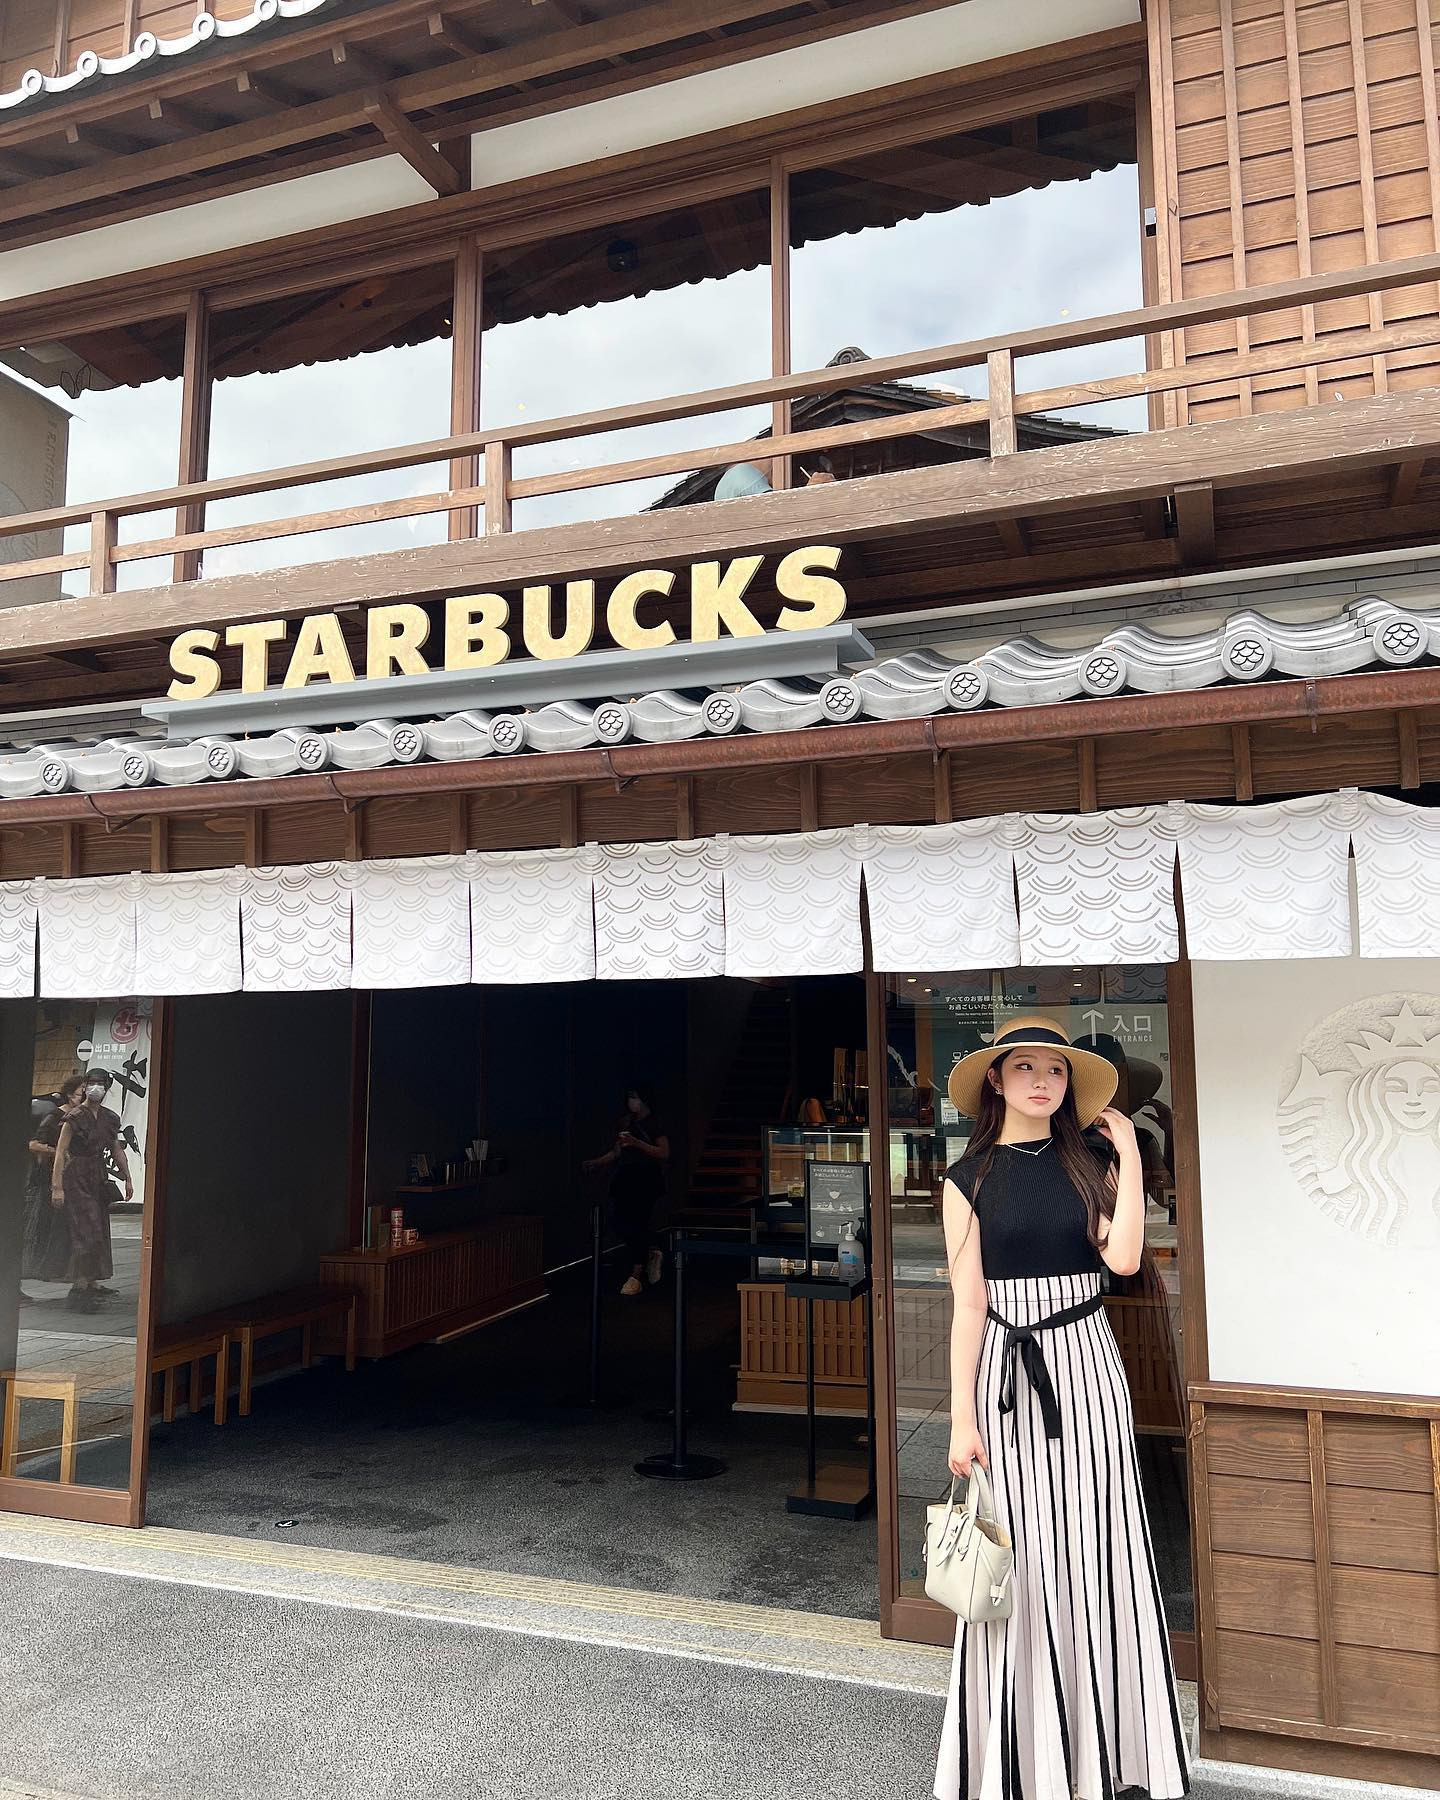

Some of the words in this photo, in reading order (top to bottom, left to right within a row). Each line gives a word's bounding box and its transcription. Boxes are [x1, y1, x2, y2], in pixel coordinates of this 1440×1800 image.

[167, 546, 847, 700] STARBUCKS
[1112, 1015, 1151, 1032] 入口
[1113, 1034, 1153, 1043] ENTRANCE
[95, 1043, 126, 1053] 出口専用
